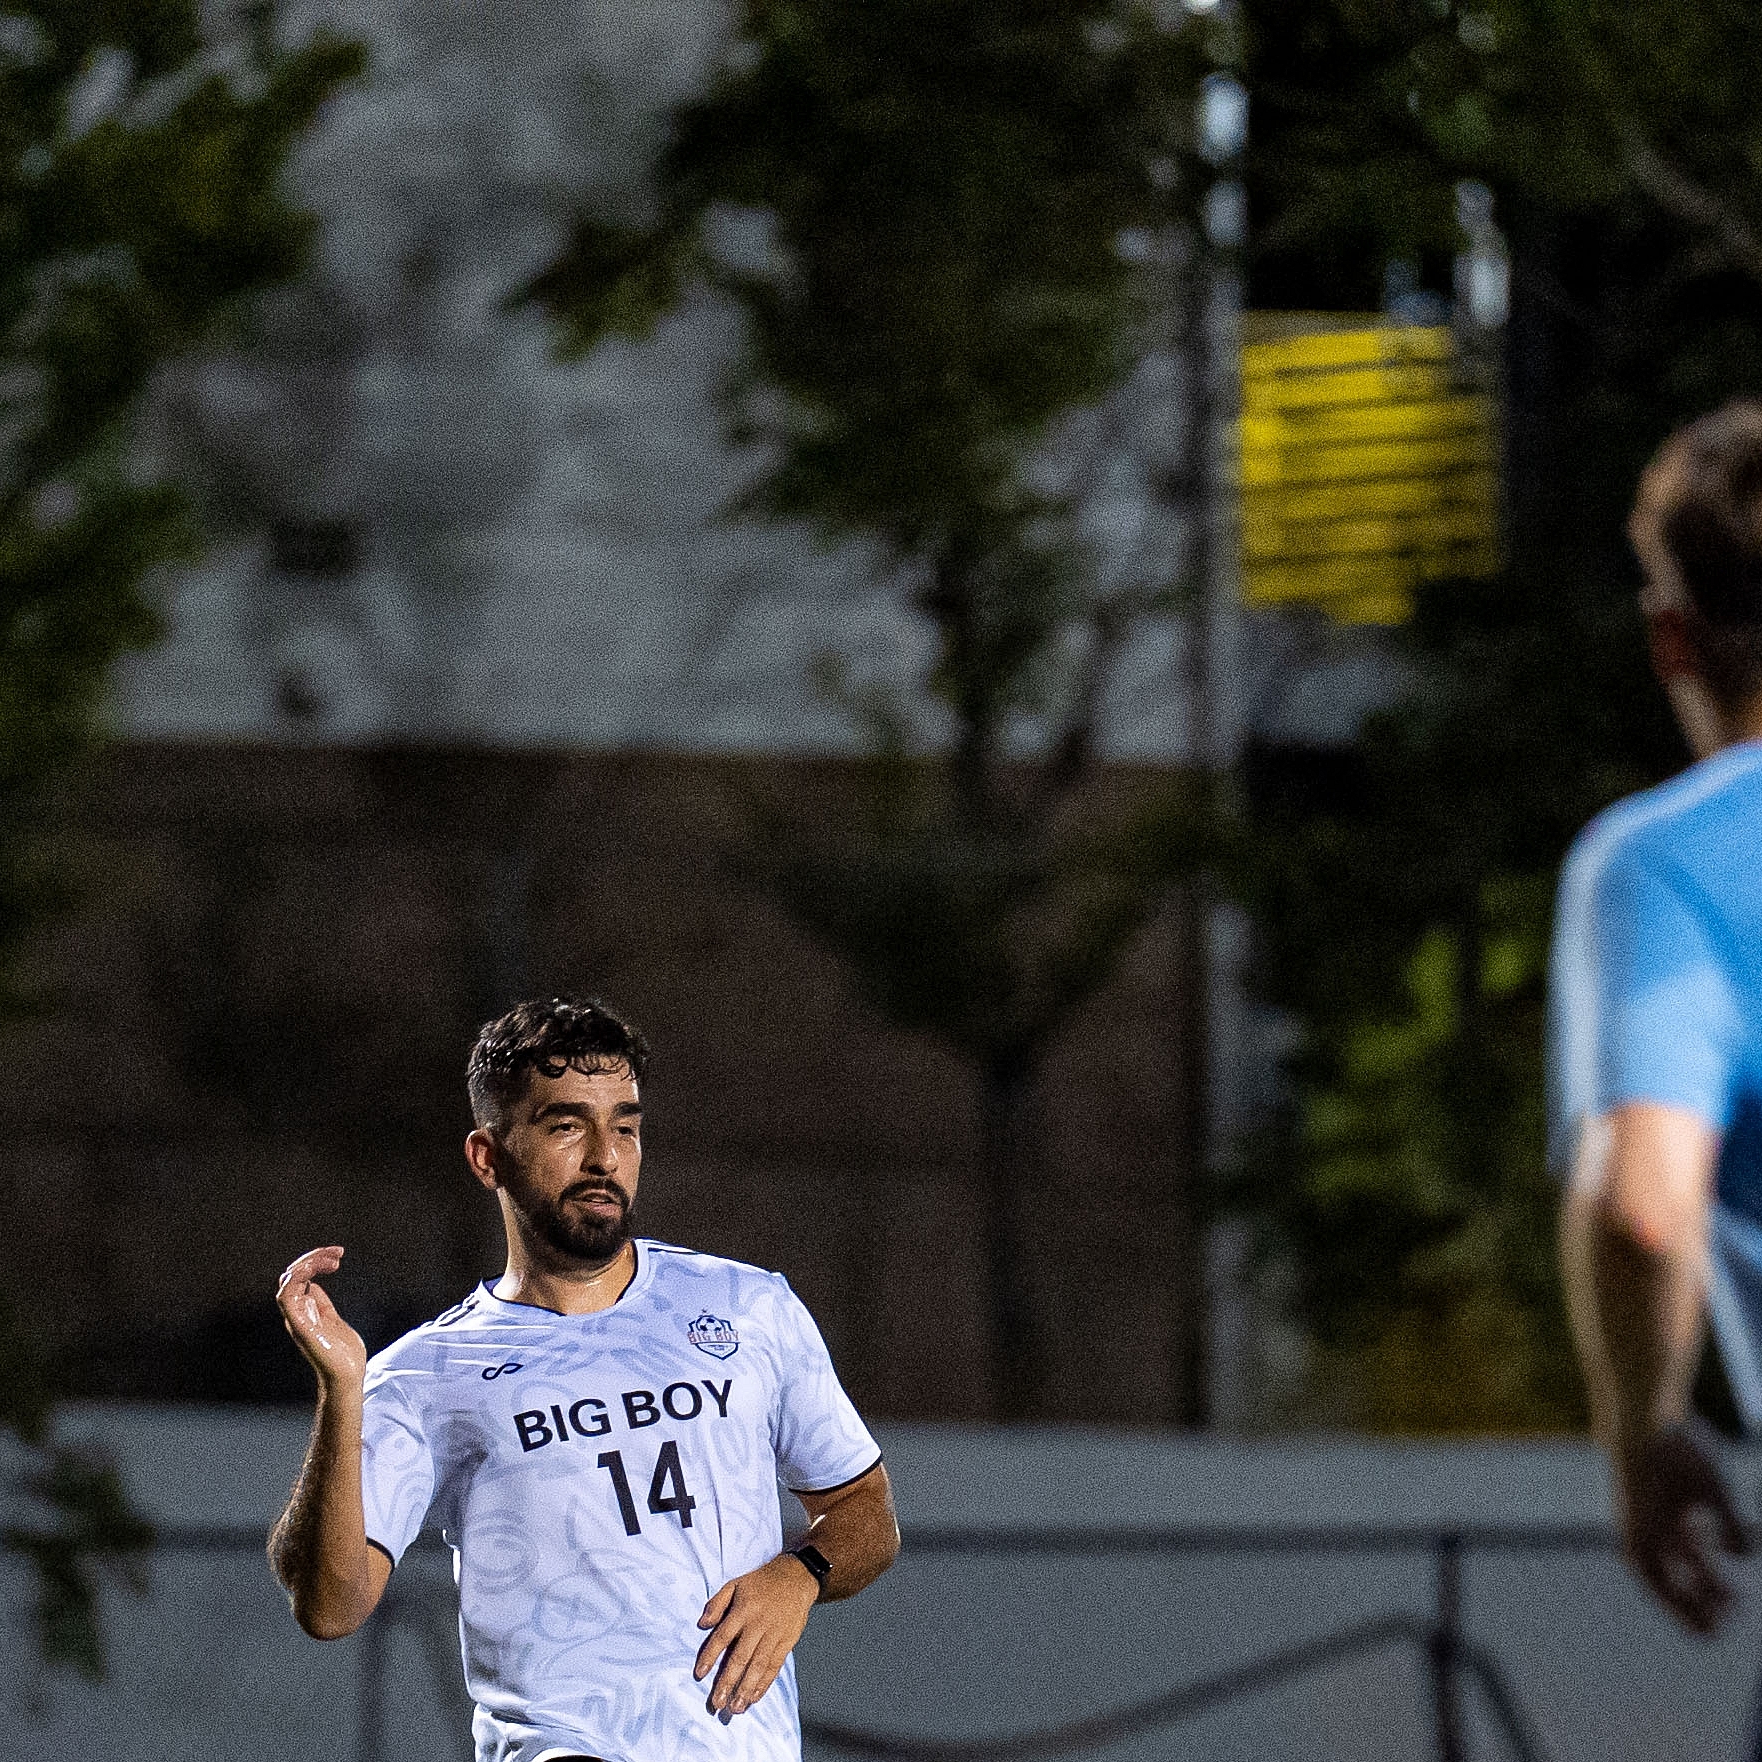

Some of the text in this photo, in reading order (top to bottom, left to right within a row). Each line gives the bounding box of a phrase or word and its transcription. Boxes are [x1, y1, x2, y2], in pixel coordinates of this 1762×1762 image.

[513, 1379, 733, 1452] BIG BOY
[597, 1440, 696, 1536] 14
